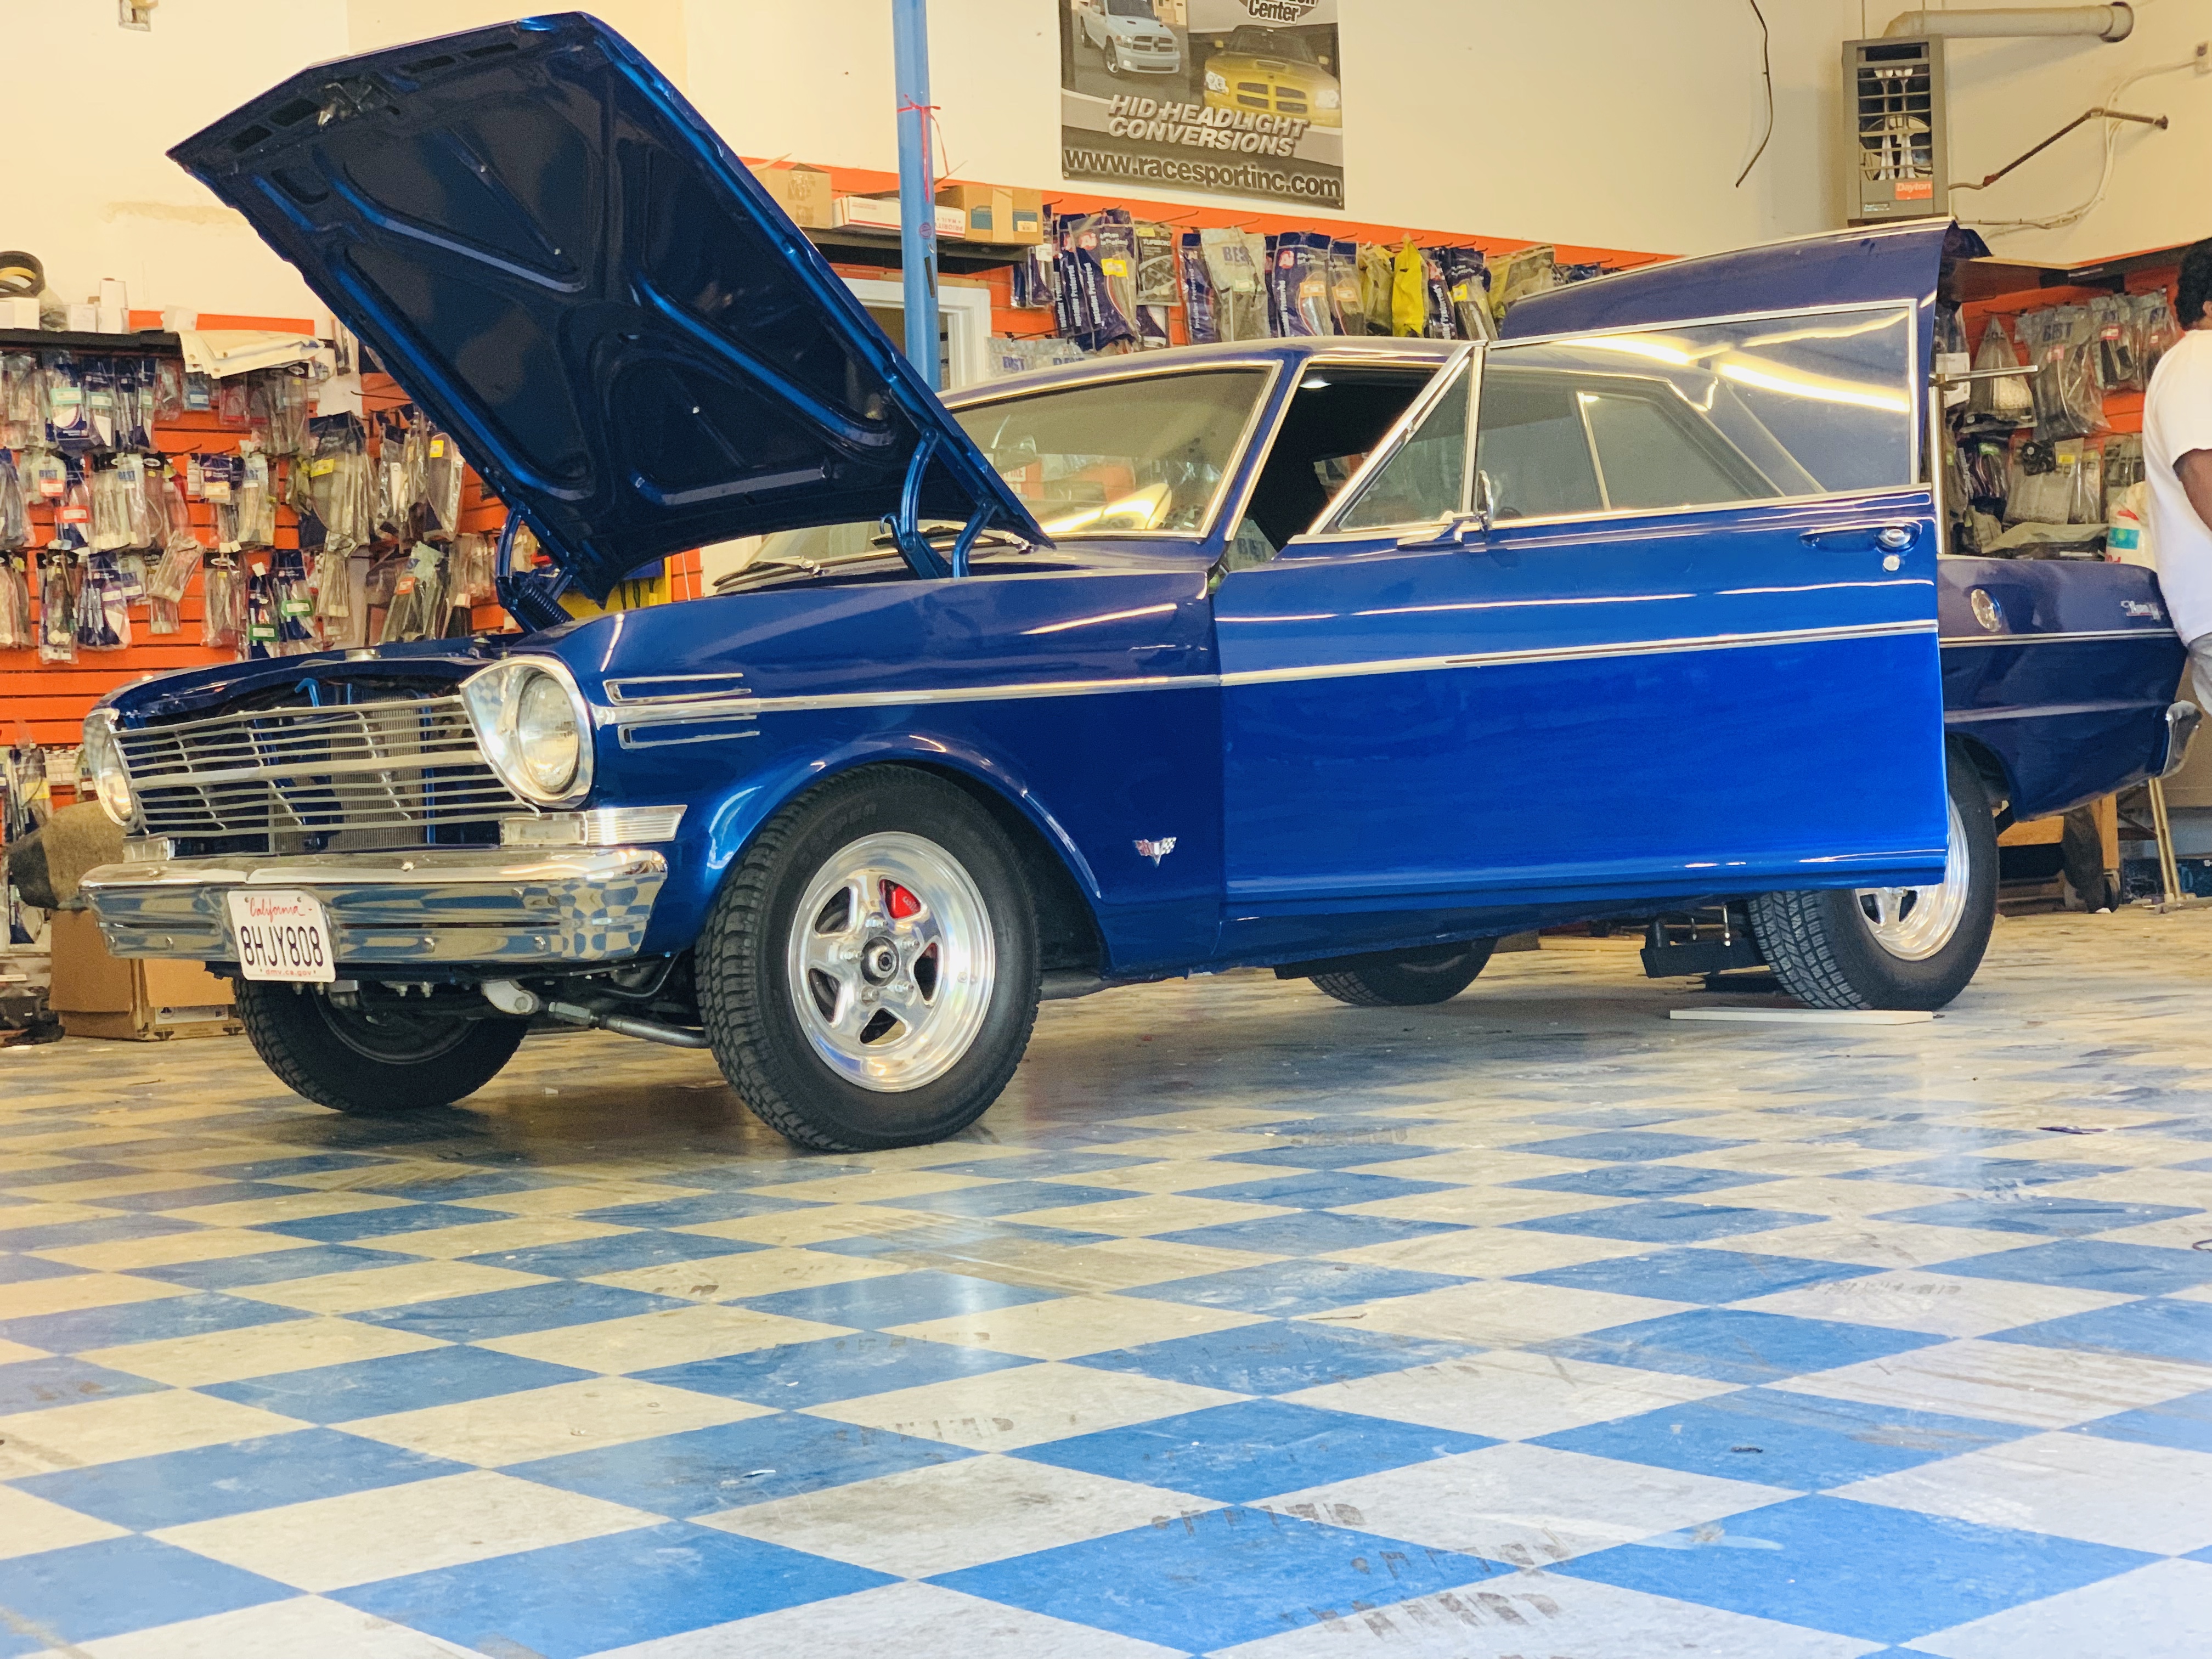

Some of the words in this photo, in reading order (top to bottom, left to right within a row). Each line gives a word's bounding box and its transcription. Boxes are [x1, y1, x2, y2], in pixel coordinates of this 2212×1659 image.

[1249, 0, 1299, 21] Center
[1108, 94, 1158, 118] HID
[1161, 101, 1309, 137] HEADLIGHT
[1108, 116, 1295, 157] CONVERSIONS
[1065, 149, 1341, 198] www.racesportinc.com
[1897, 183, 1931, 193] Dayton
[250, 898, 305, 923] California
[240, 926, 324, 967] 8HJY808
[266, 968, 312, 977] dmv.ca.gov
